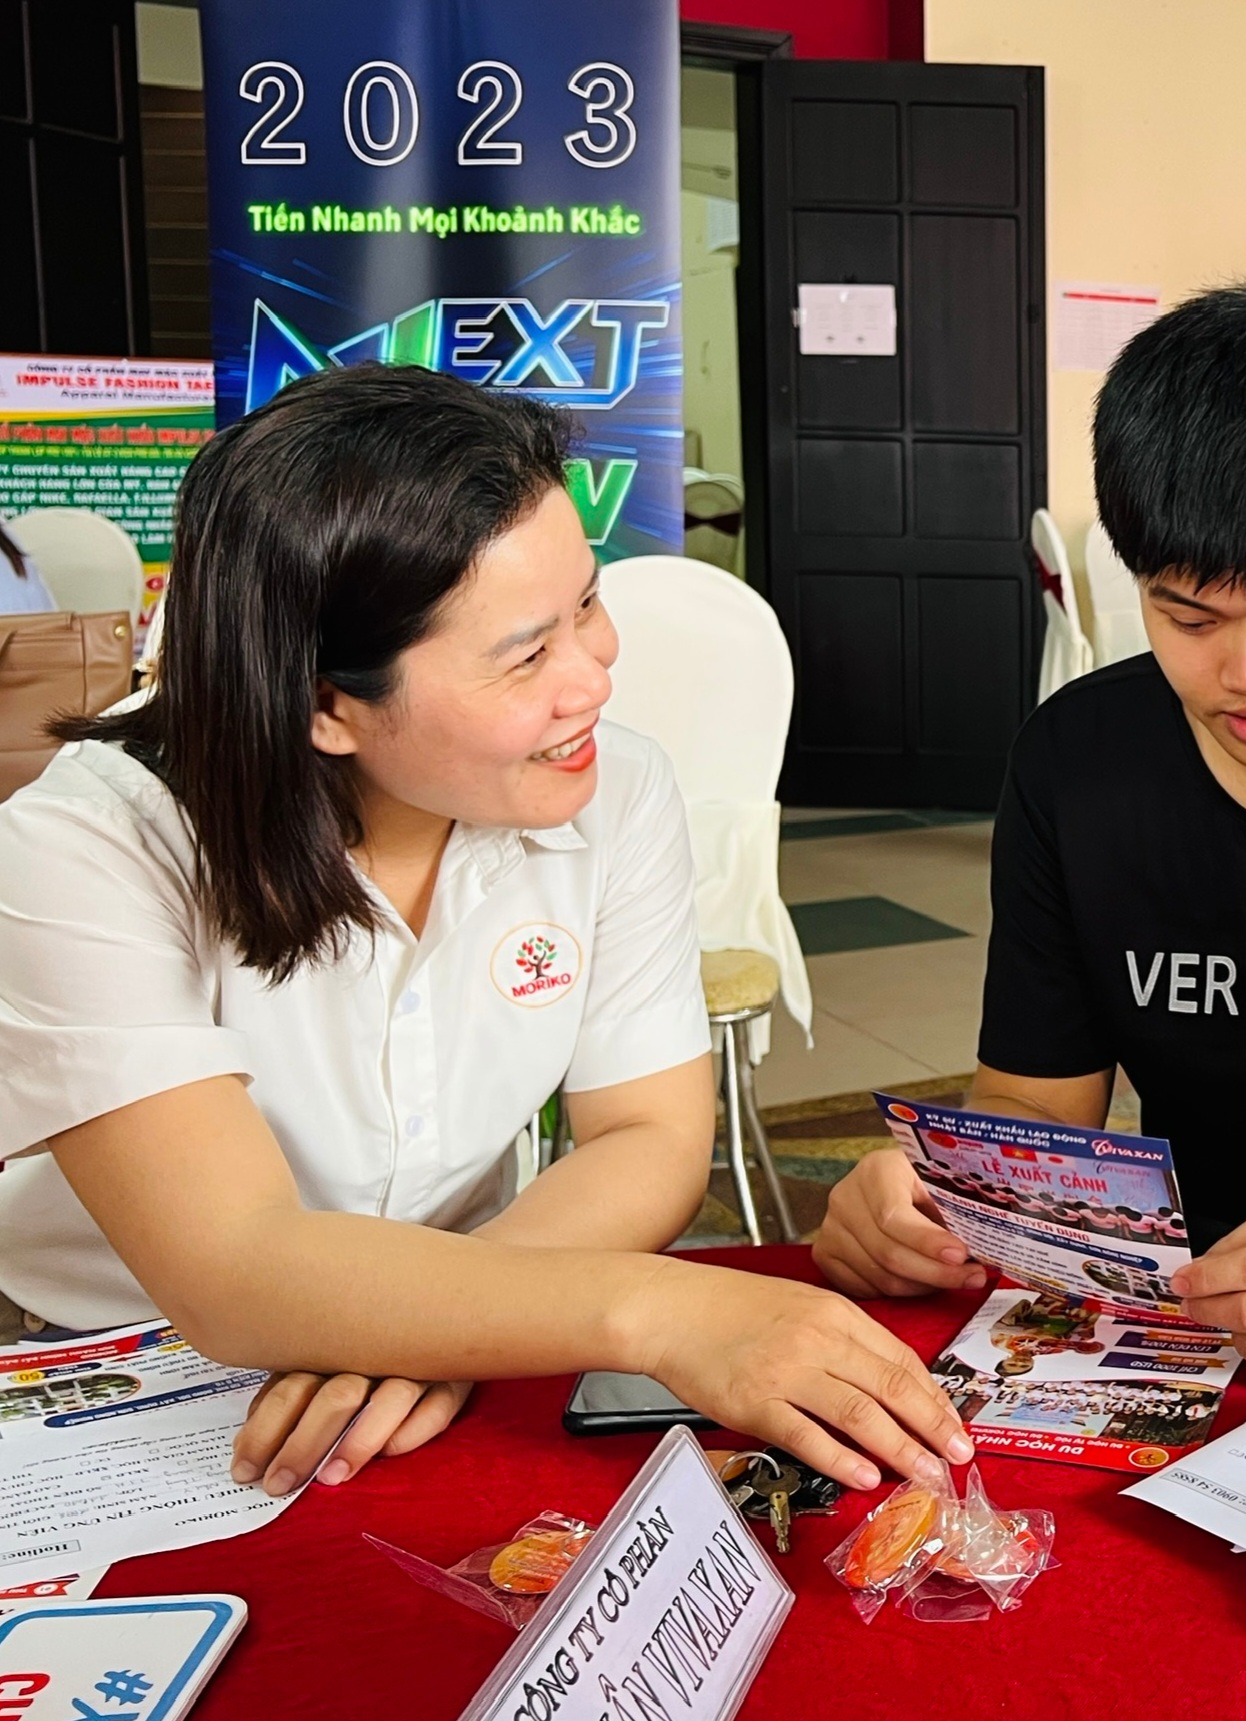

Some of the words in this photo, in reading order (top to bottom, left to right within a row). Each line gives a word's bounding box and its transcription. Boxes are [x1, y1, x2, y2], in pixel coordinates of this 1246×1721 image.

[240, 61, 637, 168] 2023
[249, 206, 304, 233] Tiến
[312, 208, 401, 233] Nhanh
[410, 208, 457, 238] Mọi
[464, 205, 563, 234] Khoảnh
[571, 205, 640, 235] Khắc
[16, 375, 98, 388] IMPULSE
[105, 378, 179, 390] FASHION
[511, 973, 572, 998] MORIKO
[1126, 950, 1239, 1016] VER
[1129, 1360, 1152, 1368] USD
[1014, 1439, 1056, 1451] HỌC
[1057, 1445, 1084, 1454] DU
[1210, 1487, 1238, 1501] 0903
[174, 1509, 237, 1525] MORIKO
[10, 1543, 67, 1557] Hotline:
[600, 1661, 674, 1721] ÂN
[642, 1520, 762, 1708] VIVAXAN
[568, 1606, 604, 1663] TY
